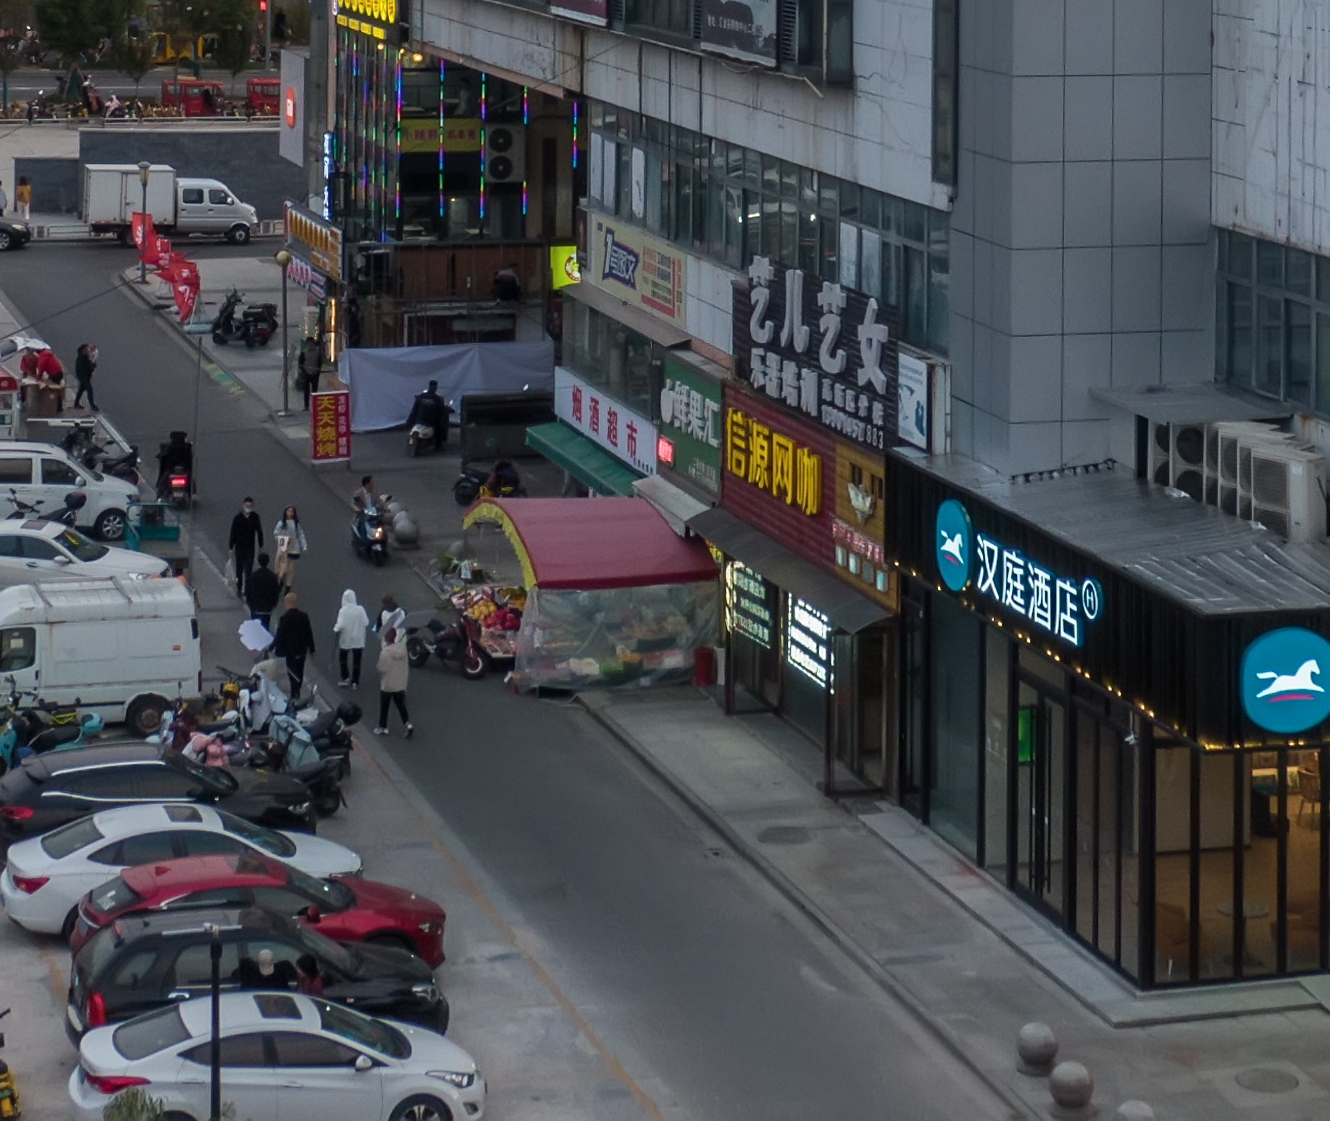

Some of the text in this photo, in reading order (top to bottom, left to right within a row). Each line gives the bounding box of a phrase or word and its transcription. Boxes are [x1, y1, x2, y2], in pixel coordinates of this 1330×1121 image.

[749, 255, 889, 395] 艺儿艺女
[316, 395, 336, 457] 天天烧烤
[572, 384, 638, 459] 烟酒超市
[726, 408, 820, 516] 信源网咖
[977, 533, 1078, 646] 汉庭酒店
